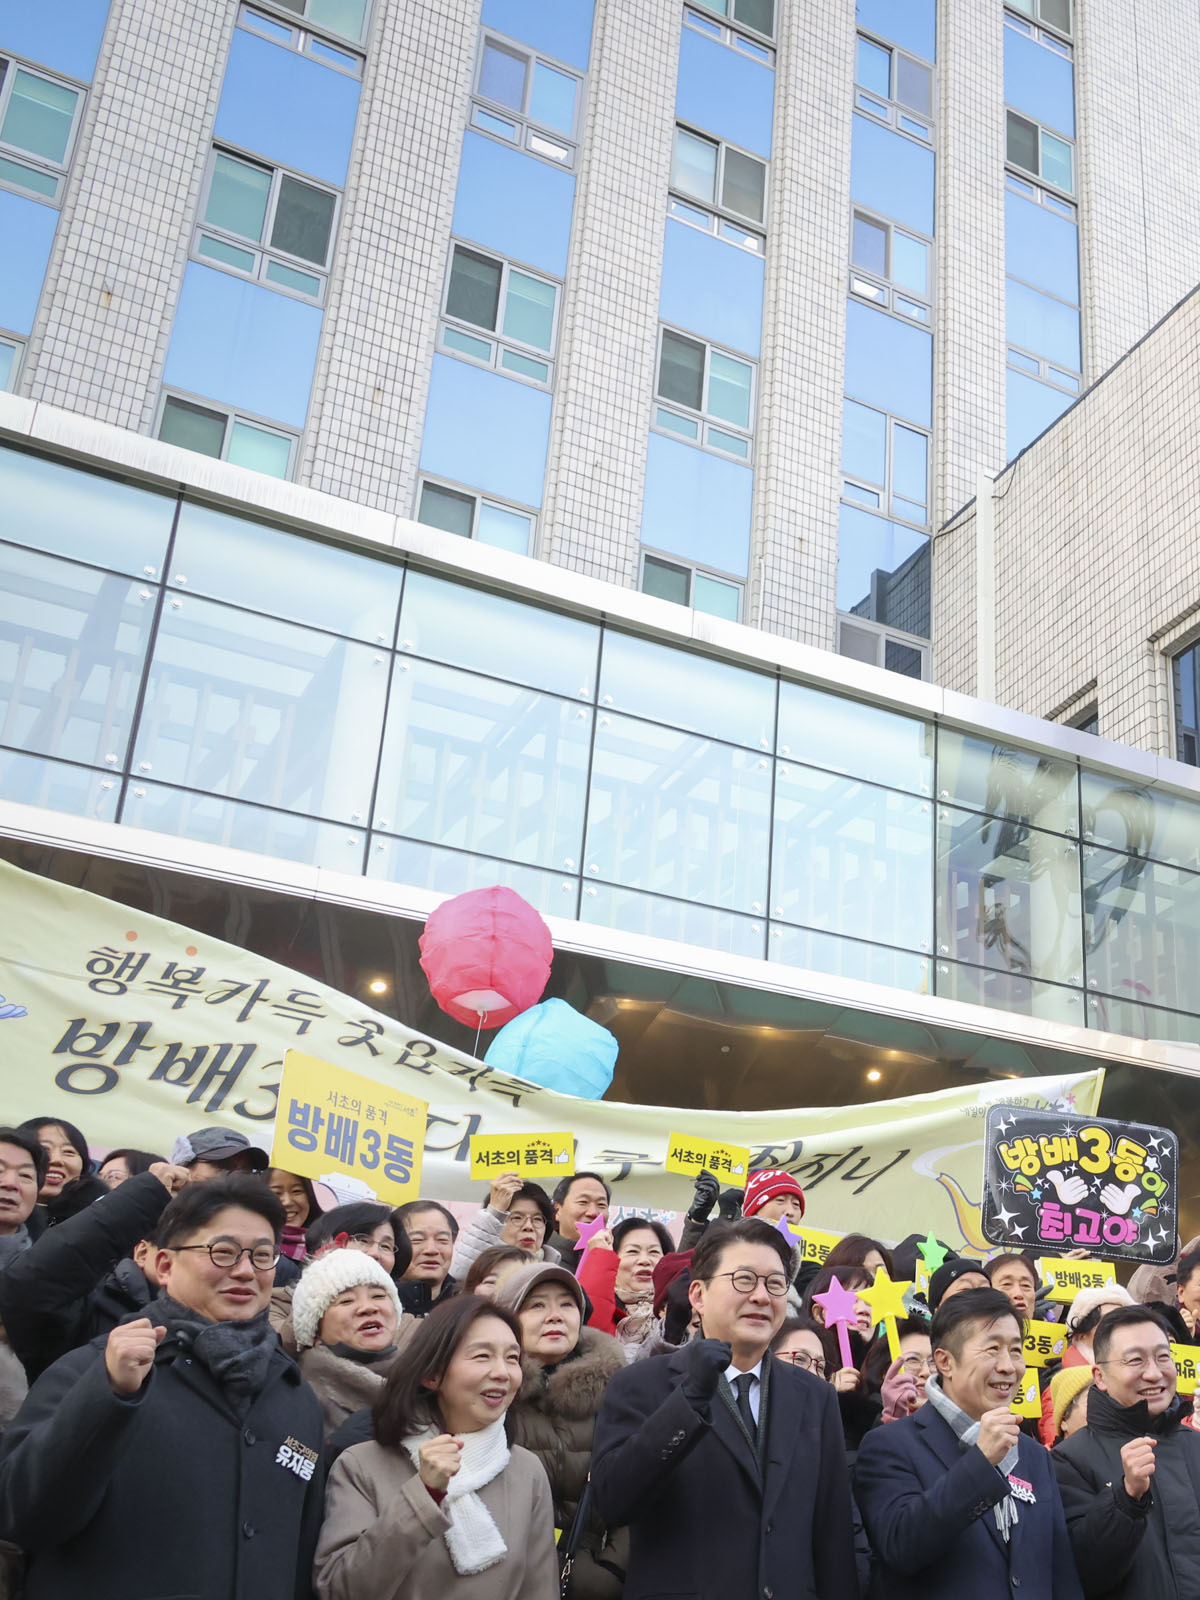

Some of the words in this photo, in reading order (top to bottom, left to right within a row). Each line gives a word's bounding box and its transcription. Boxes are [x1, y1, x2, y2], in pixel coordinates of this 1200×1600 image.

[52, 1017, 284, 1121] 방배3
[327, 1090, 362, 1116] 서초의
[365, 1104, 388, 1126] 품격
[287, 1098, 414, 1184] 방배3동
[475, 1150, 520, 1167] 서초의
[524, 1148, 554, 1165] 품격
[671, 1147, 707, 1167] 서초의
[709, 1155, 732, 1173] 품격
[1038, 1201, 1139, 1244] 최고야
[1055, 1271, 1105, 1289] 방배3동
[275, 1445, 316, 1481] 유지웅
